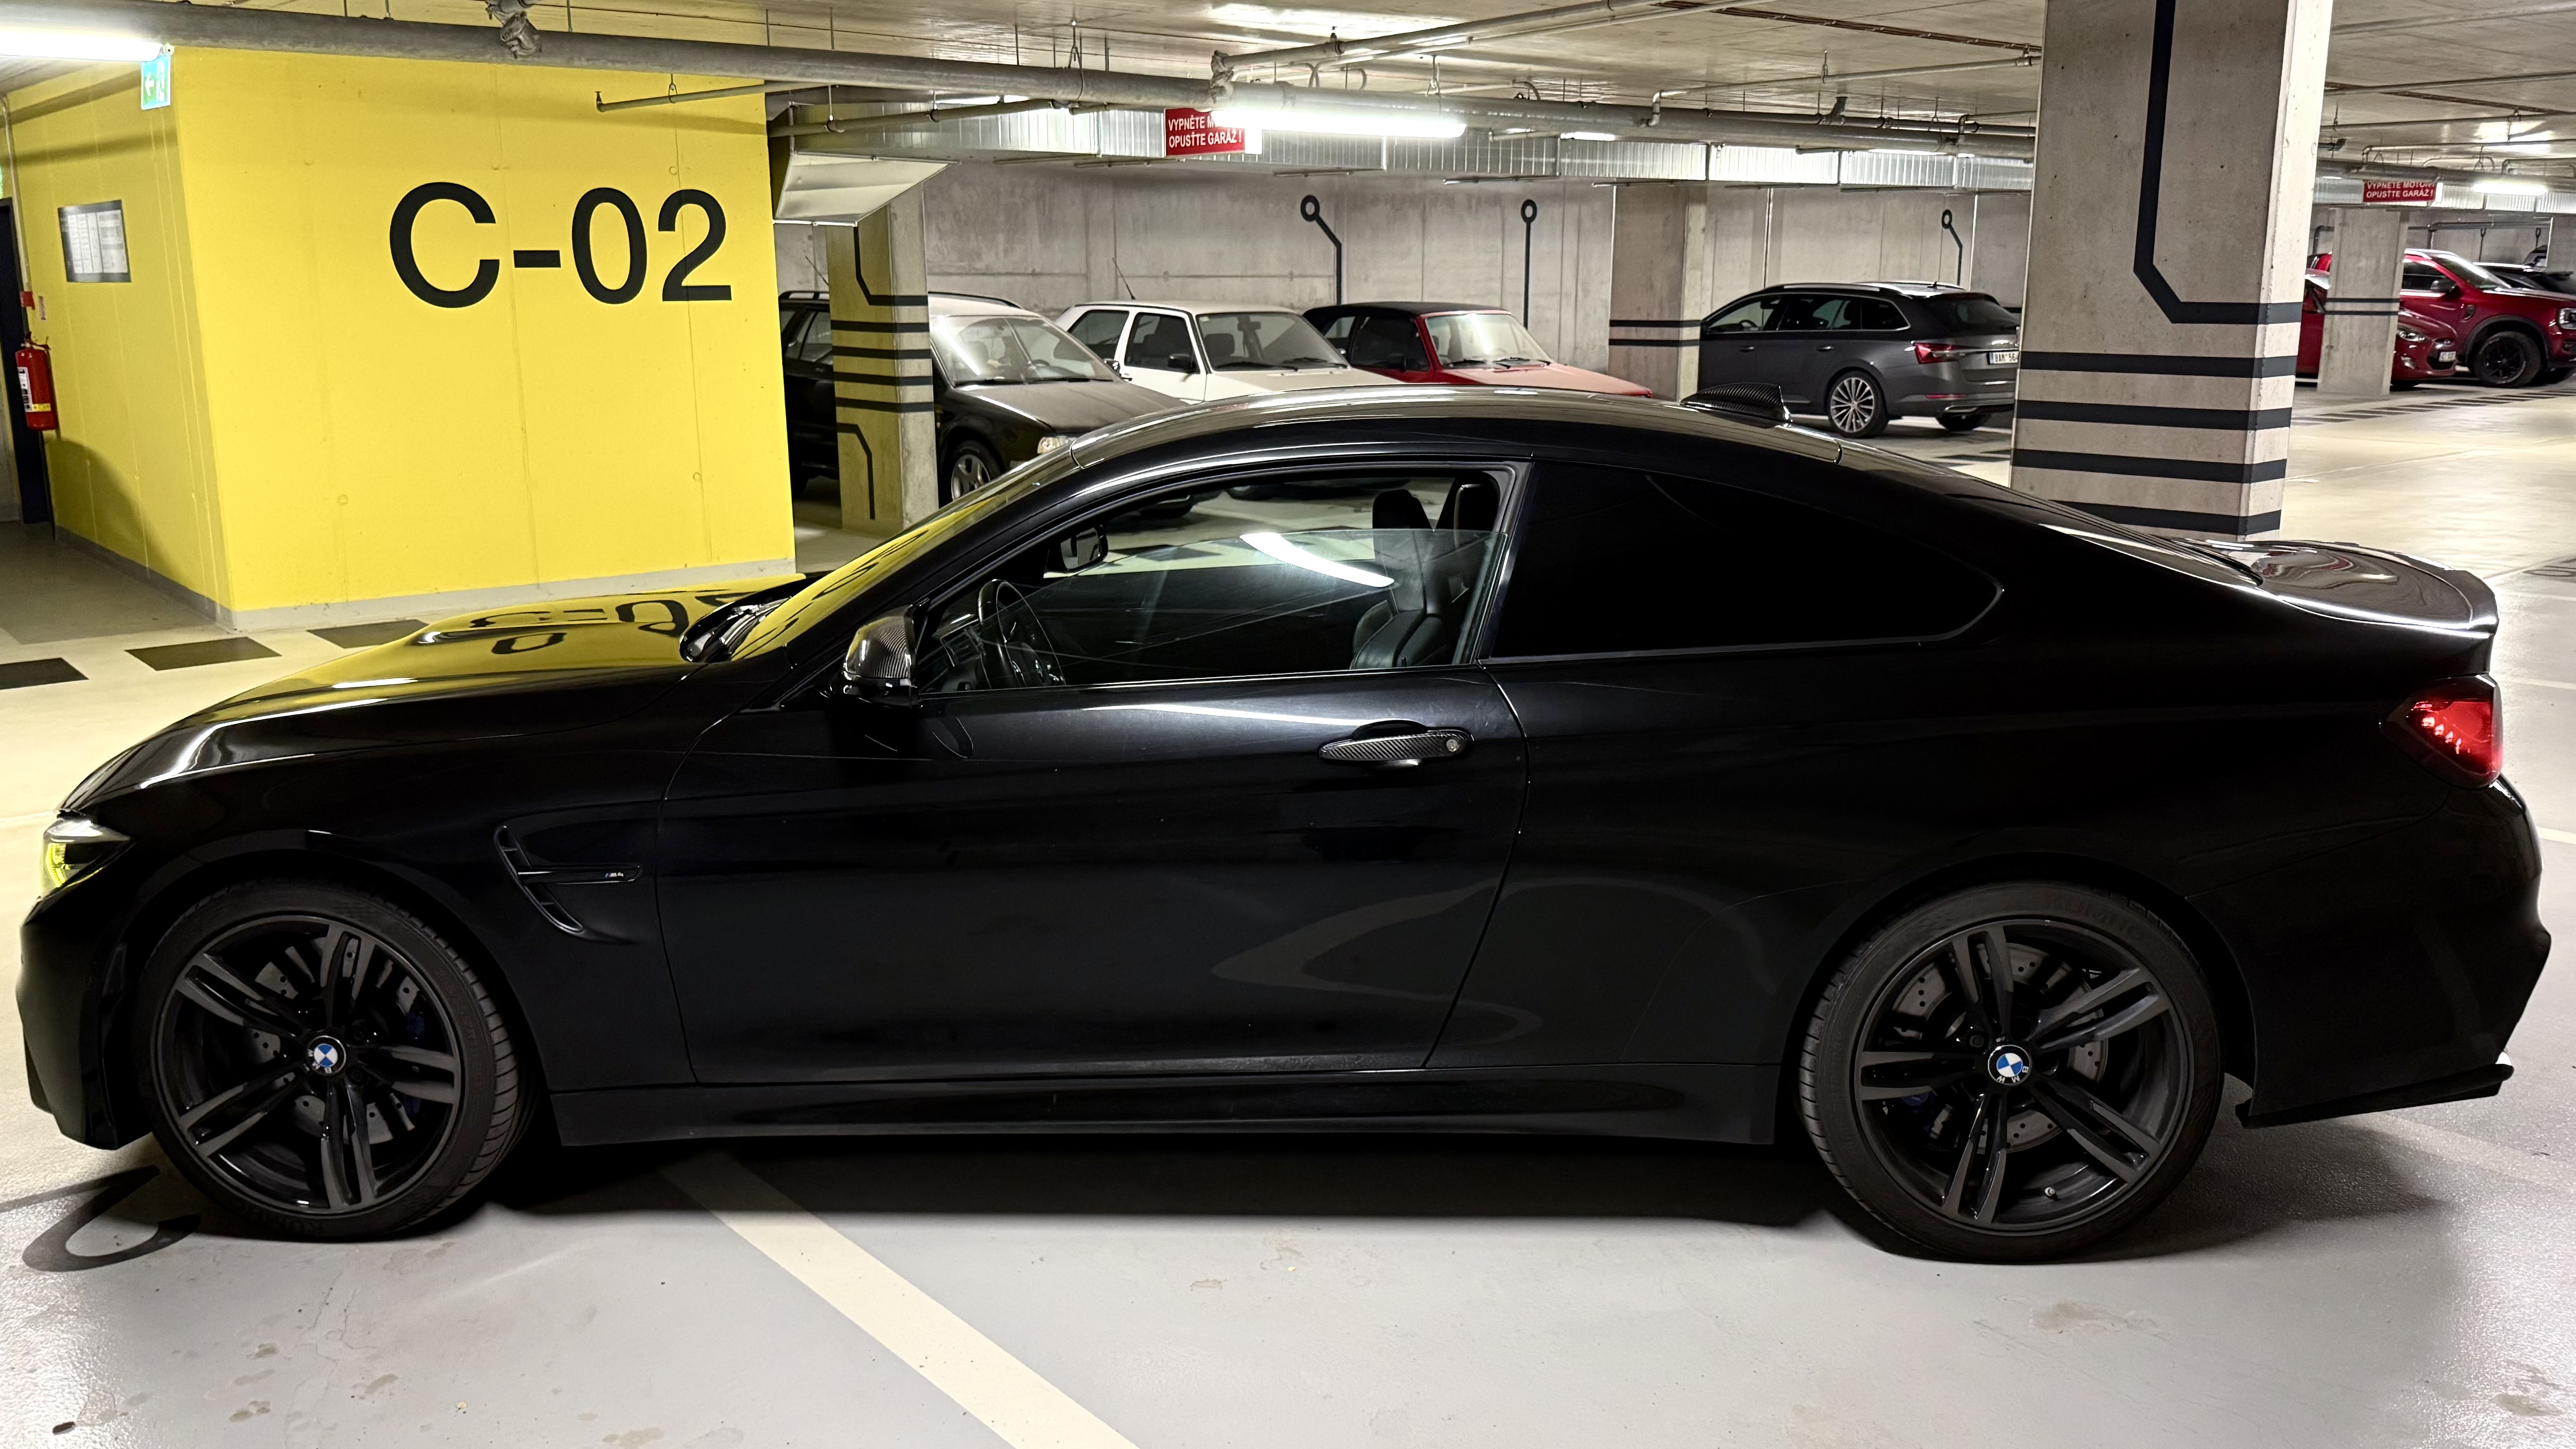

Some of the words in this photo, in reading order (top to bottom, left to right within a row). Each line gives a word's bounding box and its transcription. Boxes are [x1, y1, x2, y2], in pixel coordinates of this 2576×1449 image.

[1168, 114, 1205, 131] VYPNĚTE
[1169, 132, 1206, 148] OPUSŤTE
[390, 182, 732, 308] C-02
